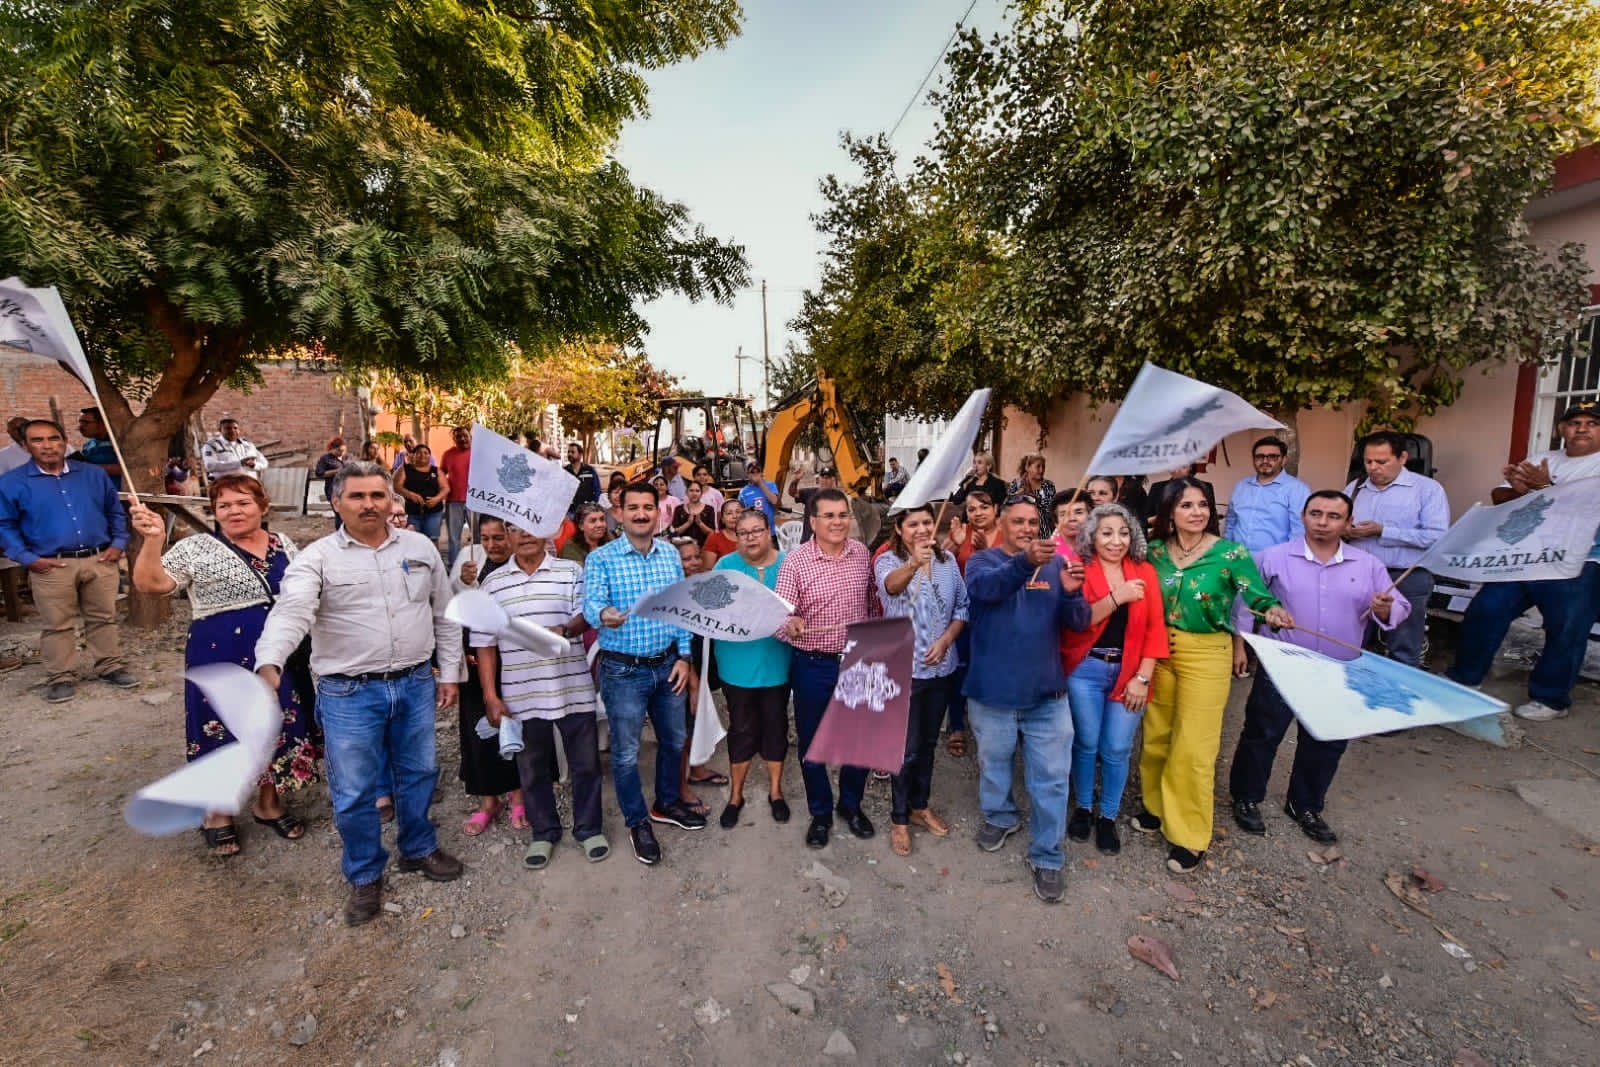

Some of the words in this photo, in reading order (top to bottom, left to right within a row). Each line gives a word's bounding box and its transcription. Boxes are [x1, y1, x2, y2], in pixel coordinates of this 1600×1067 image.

[1112, 438, 1203, 458] MAZATLÁN
[1448, 547, 1567, 568] MAZATLÁN
[651, 605, 751, 636] MAZATLÁN
